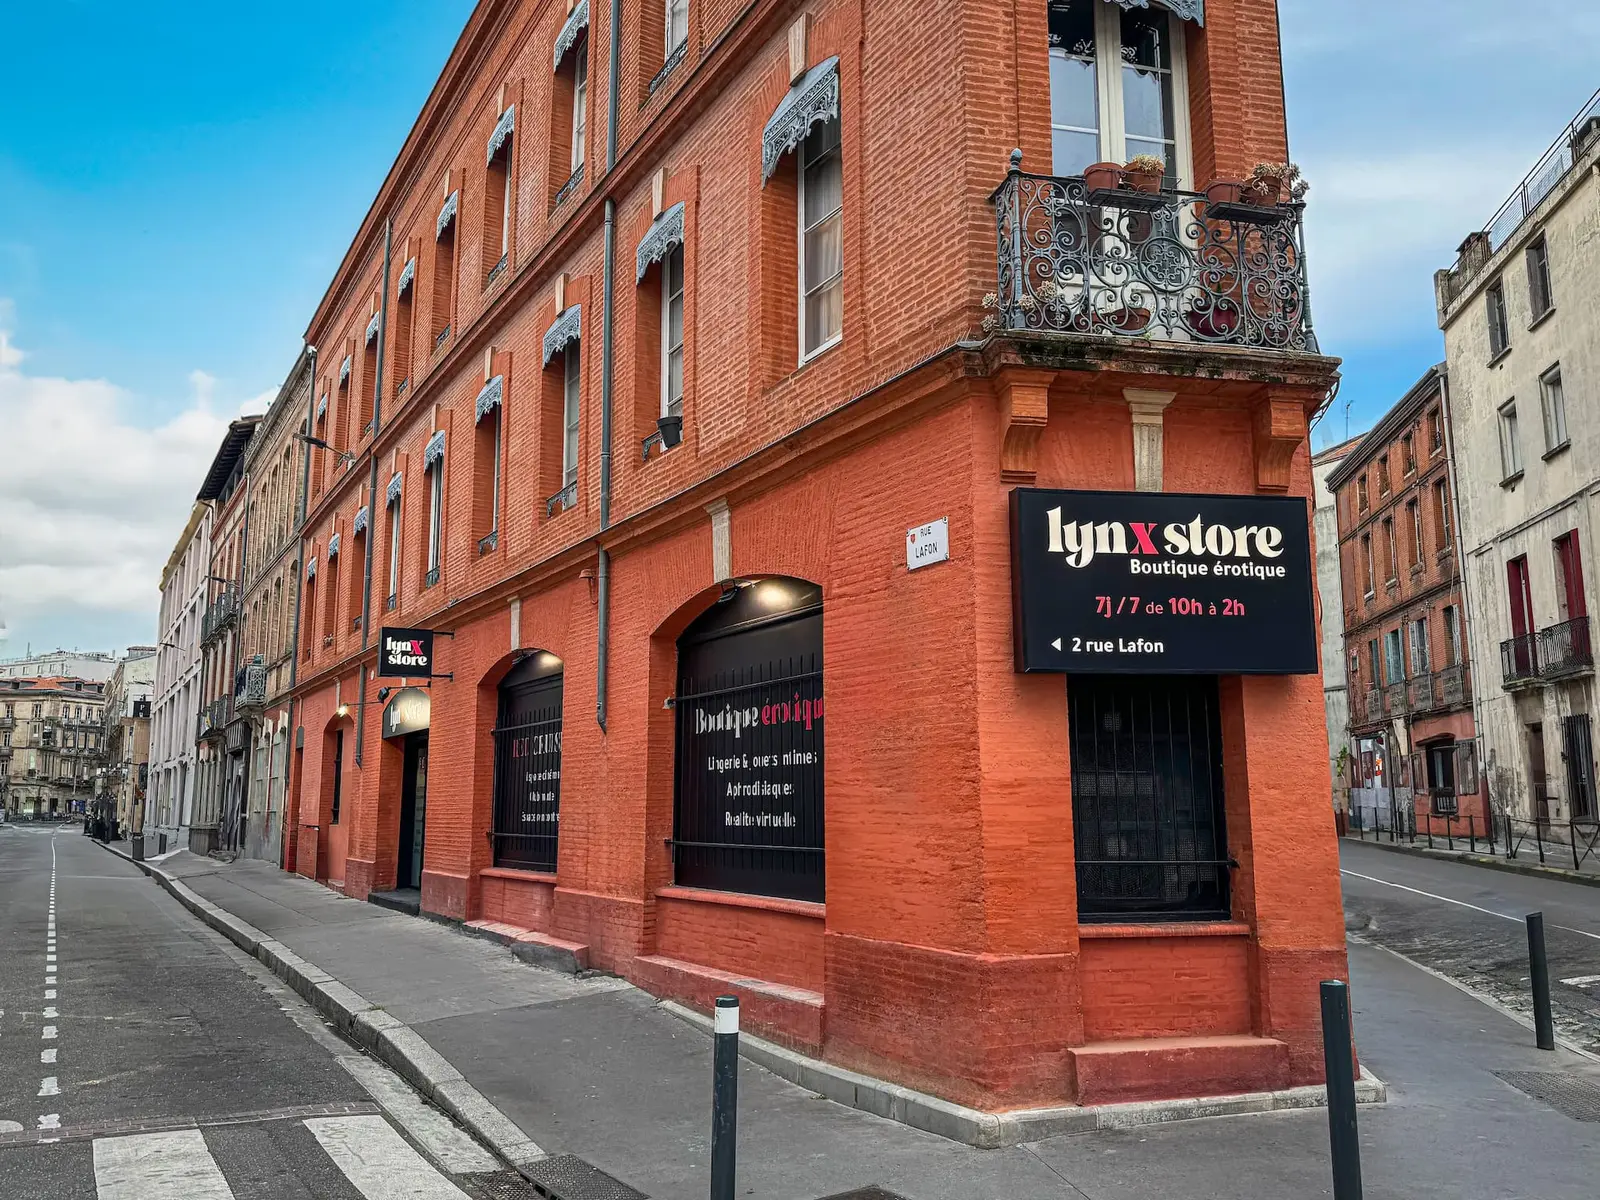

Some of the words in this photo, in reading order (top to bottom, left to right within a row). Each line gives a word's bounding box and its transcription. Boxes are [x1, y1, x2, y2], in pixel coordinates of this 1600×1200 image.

[920, 526, 932, 537] RUE
[1046, 505, 1158, 568] lynx
[1164, 513, 1284, 558] store
[916, 542, 938, 558] LAFON
[1130, 558, 1208, 578] Boutique
[1214, 560, 1286, 580] érotique
[1096, 596, 1112, 618] 7j
[1130, 597, 1140, 614] 7
[1146, 601, 1163, 615] de
[1168, 598, 1202, 615] 10h
[1208, 602, 1216, 615] à
[1222, 598, 1245, 616] 2h
[1072, 638, 1081, 652] 2
[1086, 641, 1113, 653] rue
[1118, 638, 1164, 653] Lafon
[388, 652, 428, 666] store
[695, 703, 759, 738] Boutique
[708, 754, 740, 774] Lingerie
[742, 754, 748, 768] &
[756, 811, 796, 827] virtuelle
